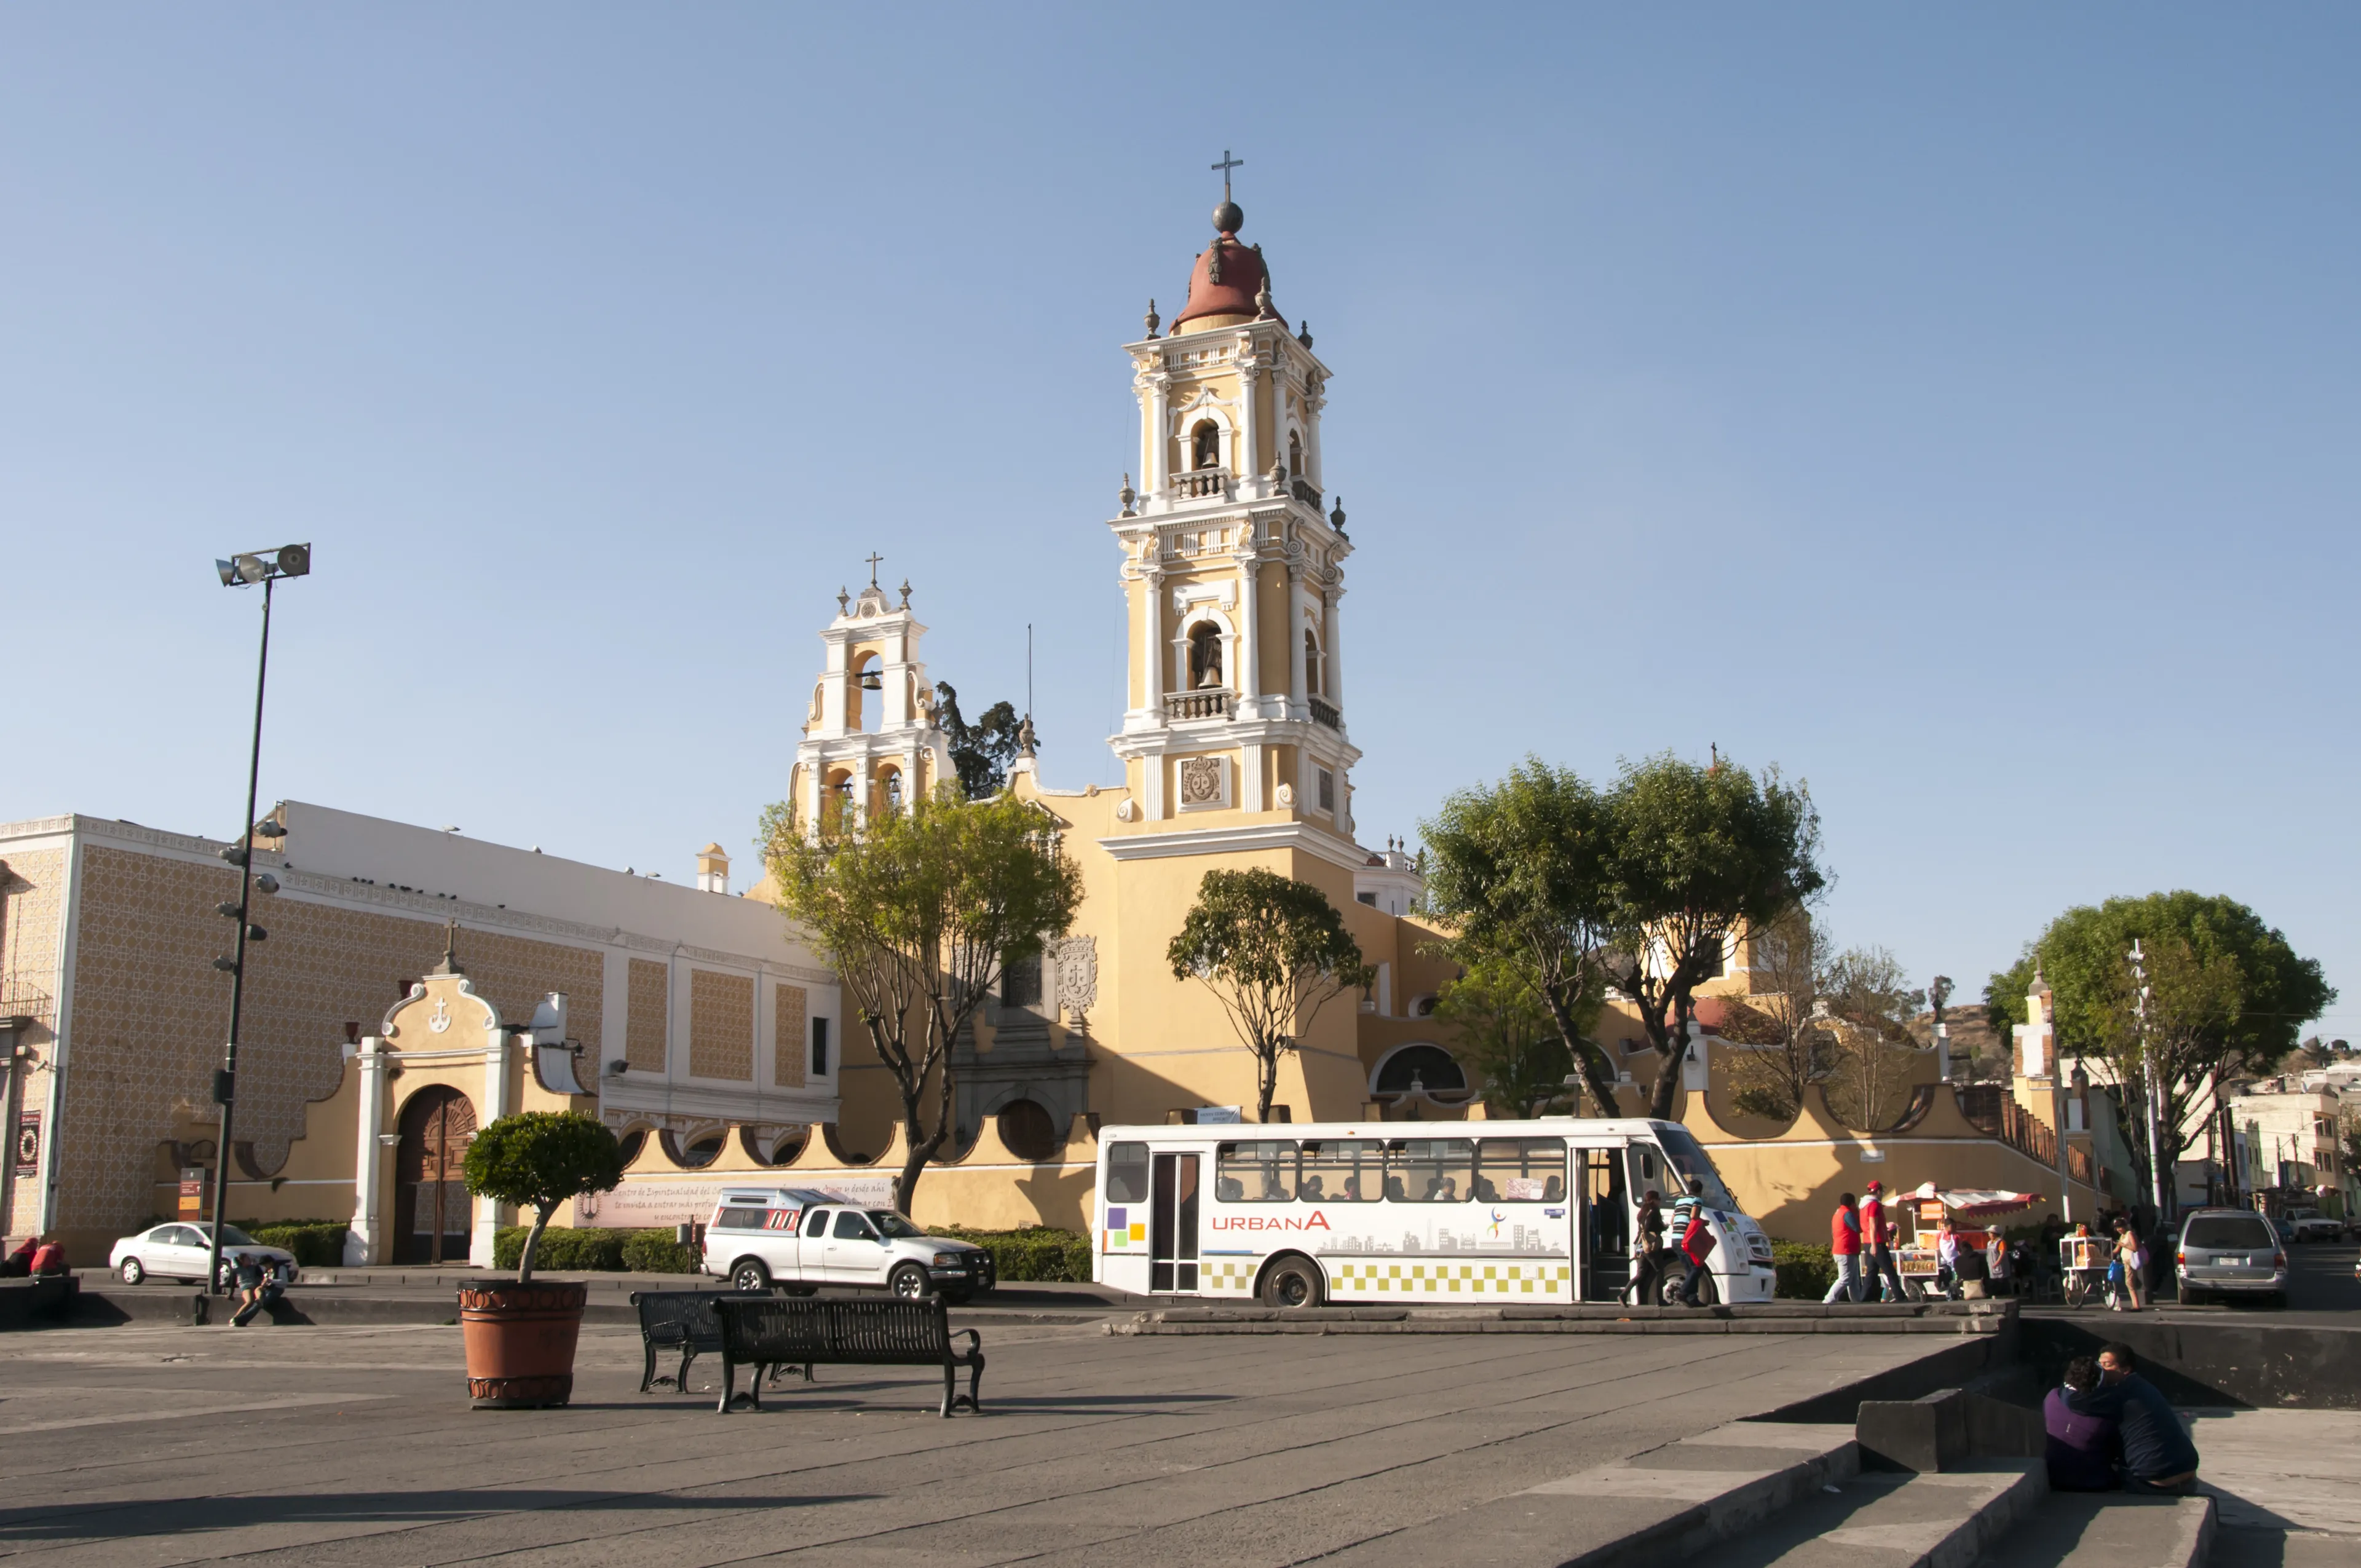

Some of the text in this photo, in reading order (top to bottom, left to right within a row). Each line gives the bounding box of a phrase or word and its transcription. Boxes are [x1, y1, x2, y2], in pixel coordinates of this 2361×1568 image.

[614, 1187, 636, 1197] Centro
[638, 1187, 645, 1197] de
[647, 1186, 699, 1200] Espiritualidad
[700, 1186, 710, 1196] del
[712, 1187, 722, 1196] Ca
[822, 1184, 842, 1193] Amor
[852, 1183, 869, 1196] desde
[623, 1200, 646, 1209] invita
[694, 1199, 718, 1213] profun
[660, 1212, 701, 1221] encontrate
[1212, 1210, 1331, 1230] URBANA
